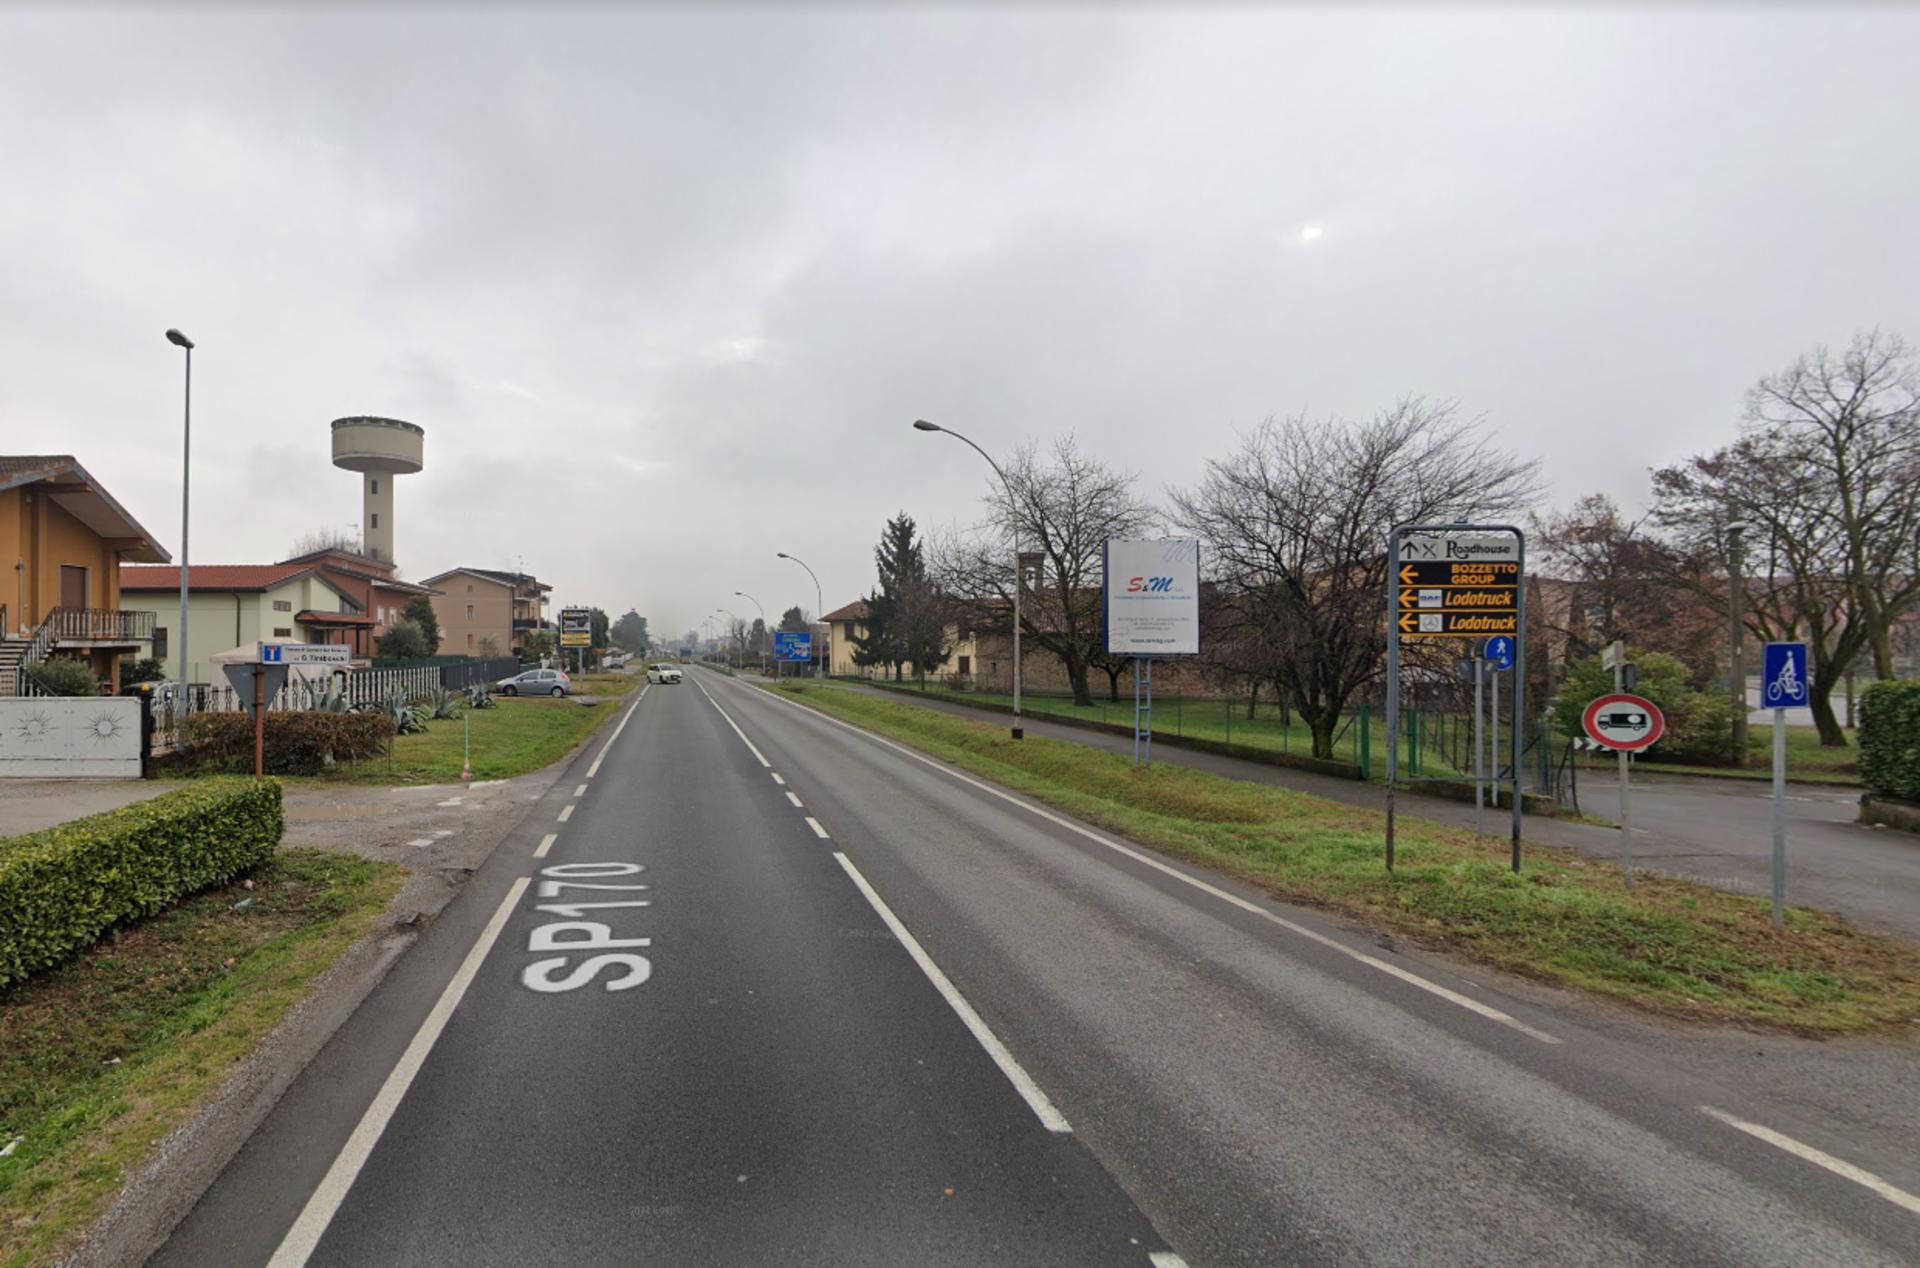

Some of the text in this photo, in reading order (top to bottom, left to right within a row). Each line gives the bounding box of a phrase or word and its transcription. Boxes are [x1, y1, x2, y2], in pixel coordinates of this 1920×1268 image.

[1446, 540, 1510, 559] Roadhouse
[1451, 564, 1517, 573] BOZZETTO
[1451, 575, 1495, 584] GROUP
[1445, 592, 1512, 606] Lodotruck
[1449, 616, 1516, 630] Lodotruck
